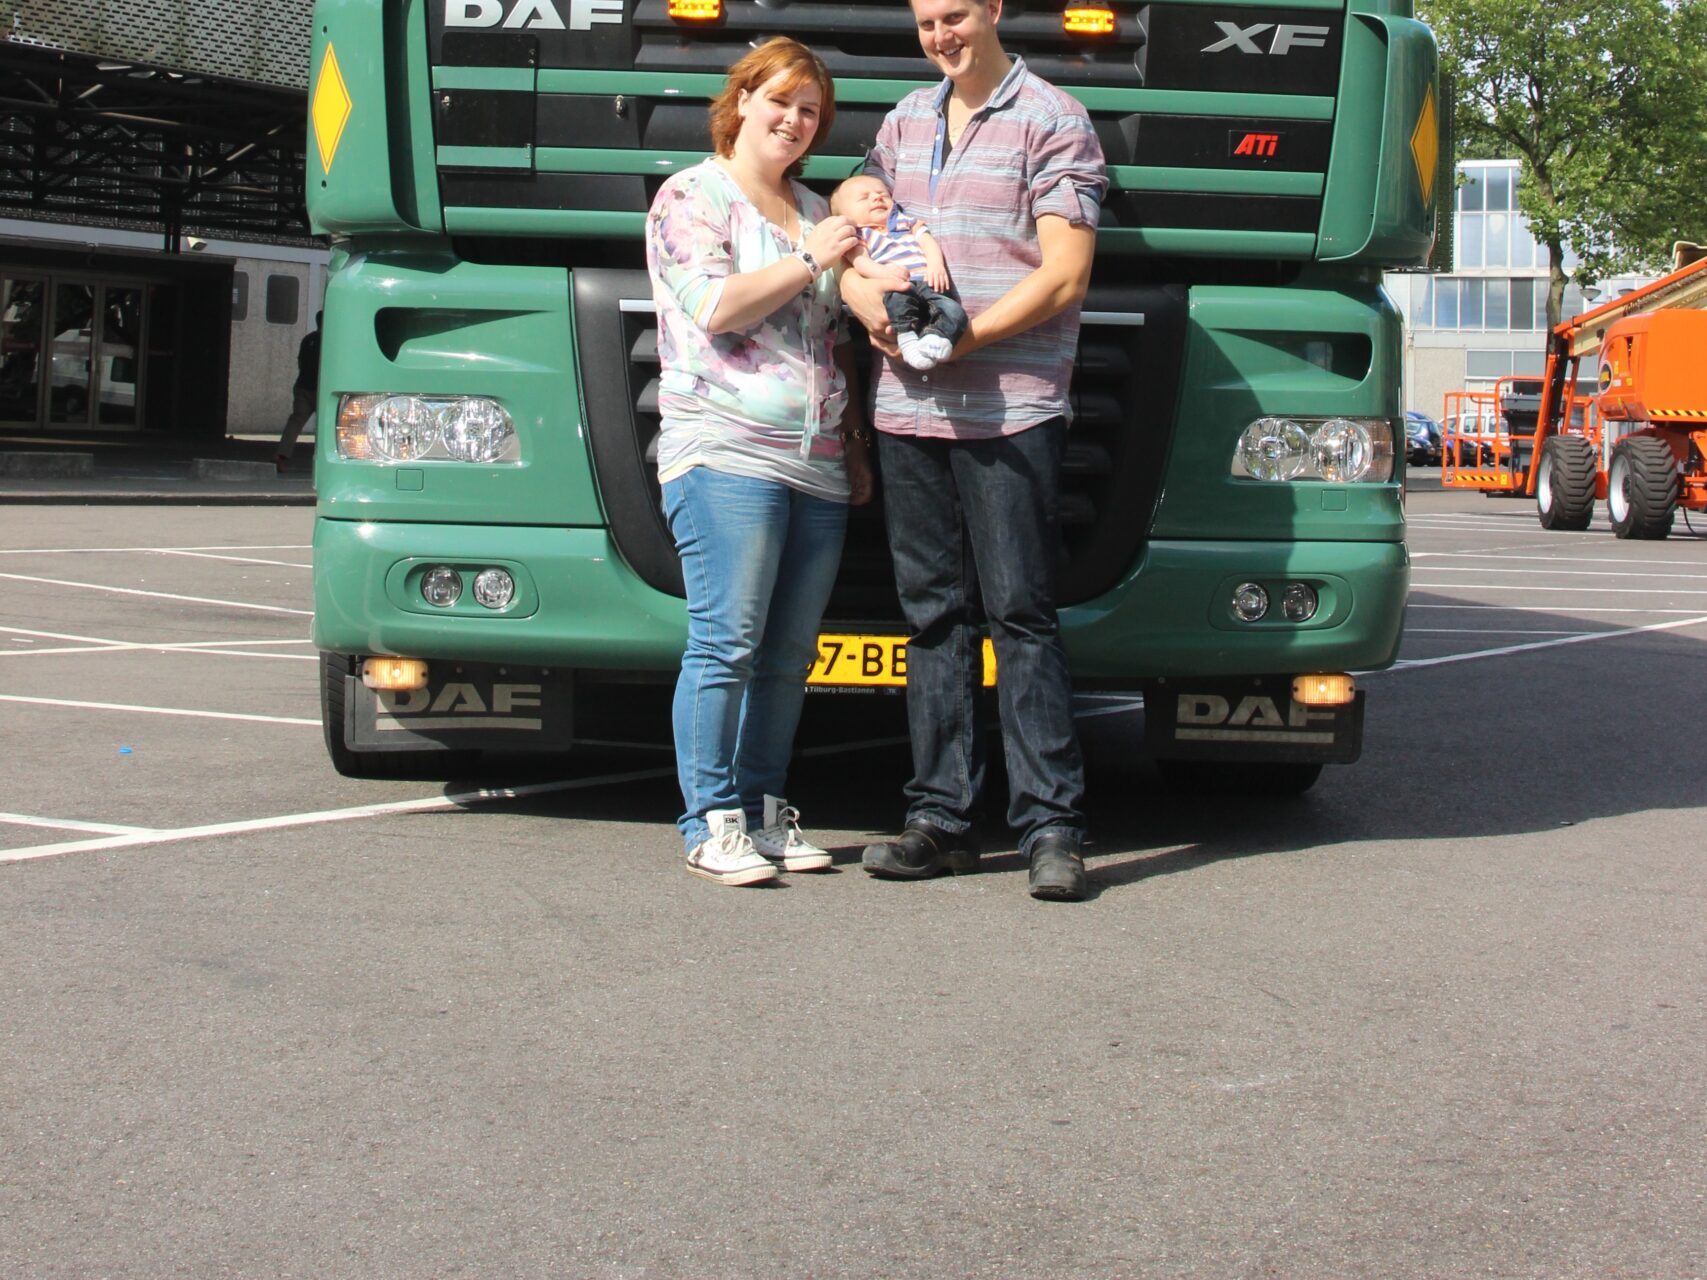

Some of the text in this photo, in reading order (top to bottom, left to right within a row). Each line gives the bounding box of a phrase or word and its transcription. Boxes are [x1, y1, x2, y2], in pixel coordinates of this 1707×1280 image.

[1200, 21, 1330, 56] XF
[1233, 134, 1279, 156] ATi
[376, 682, 542, 713] DAF
[1176, 693, 1336, 727] DAF
